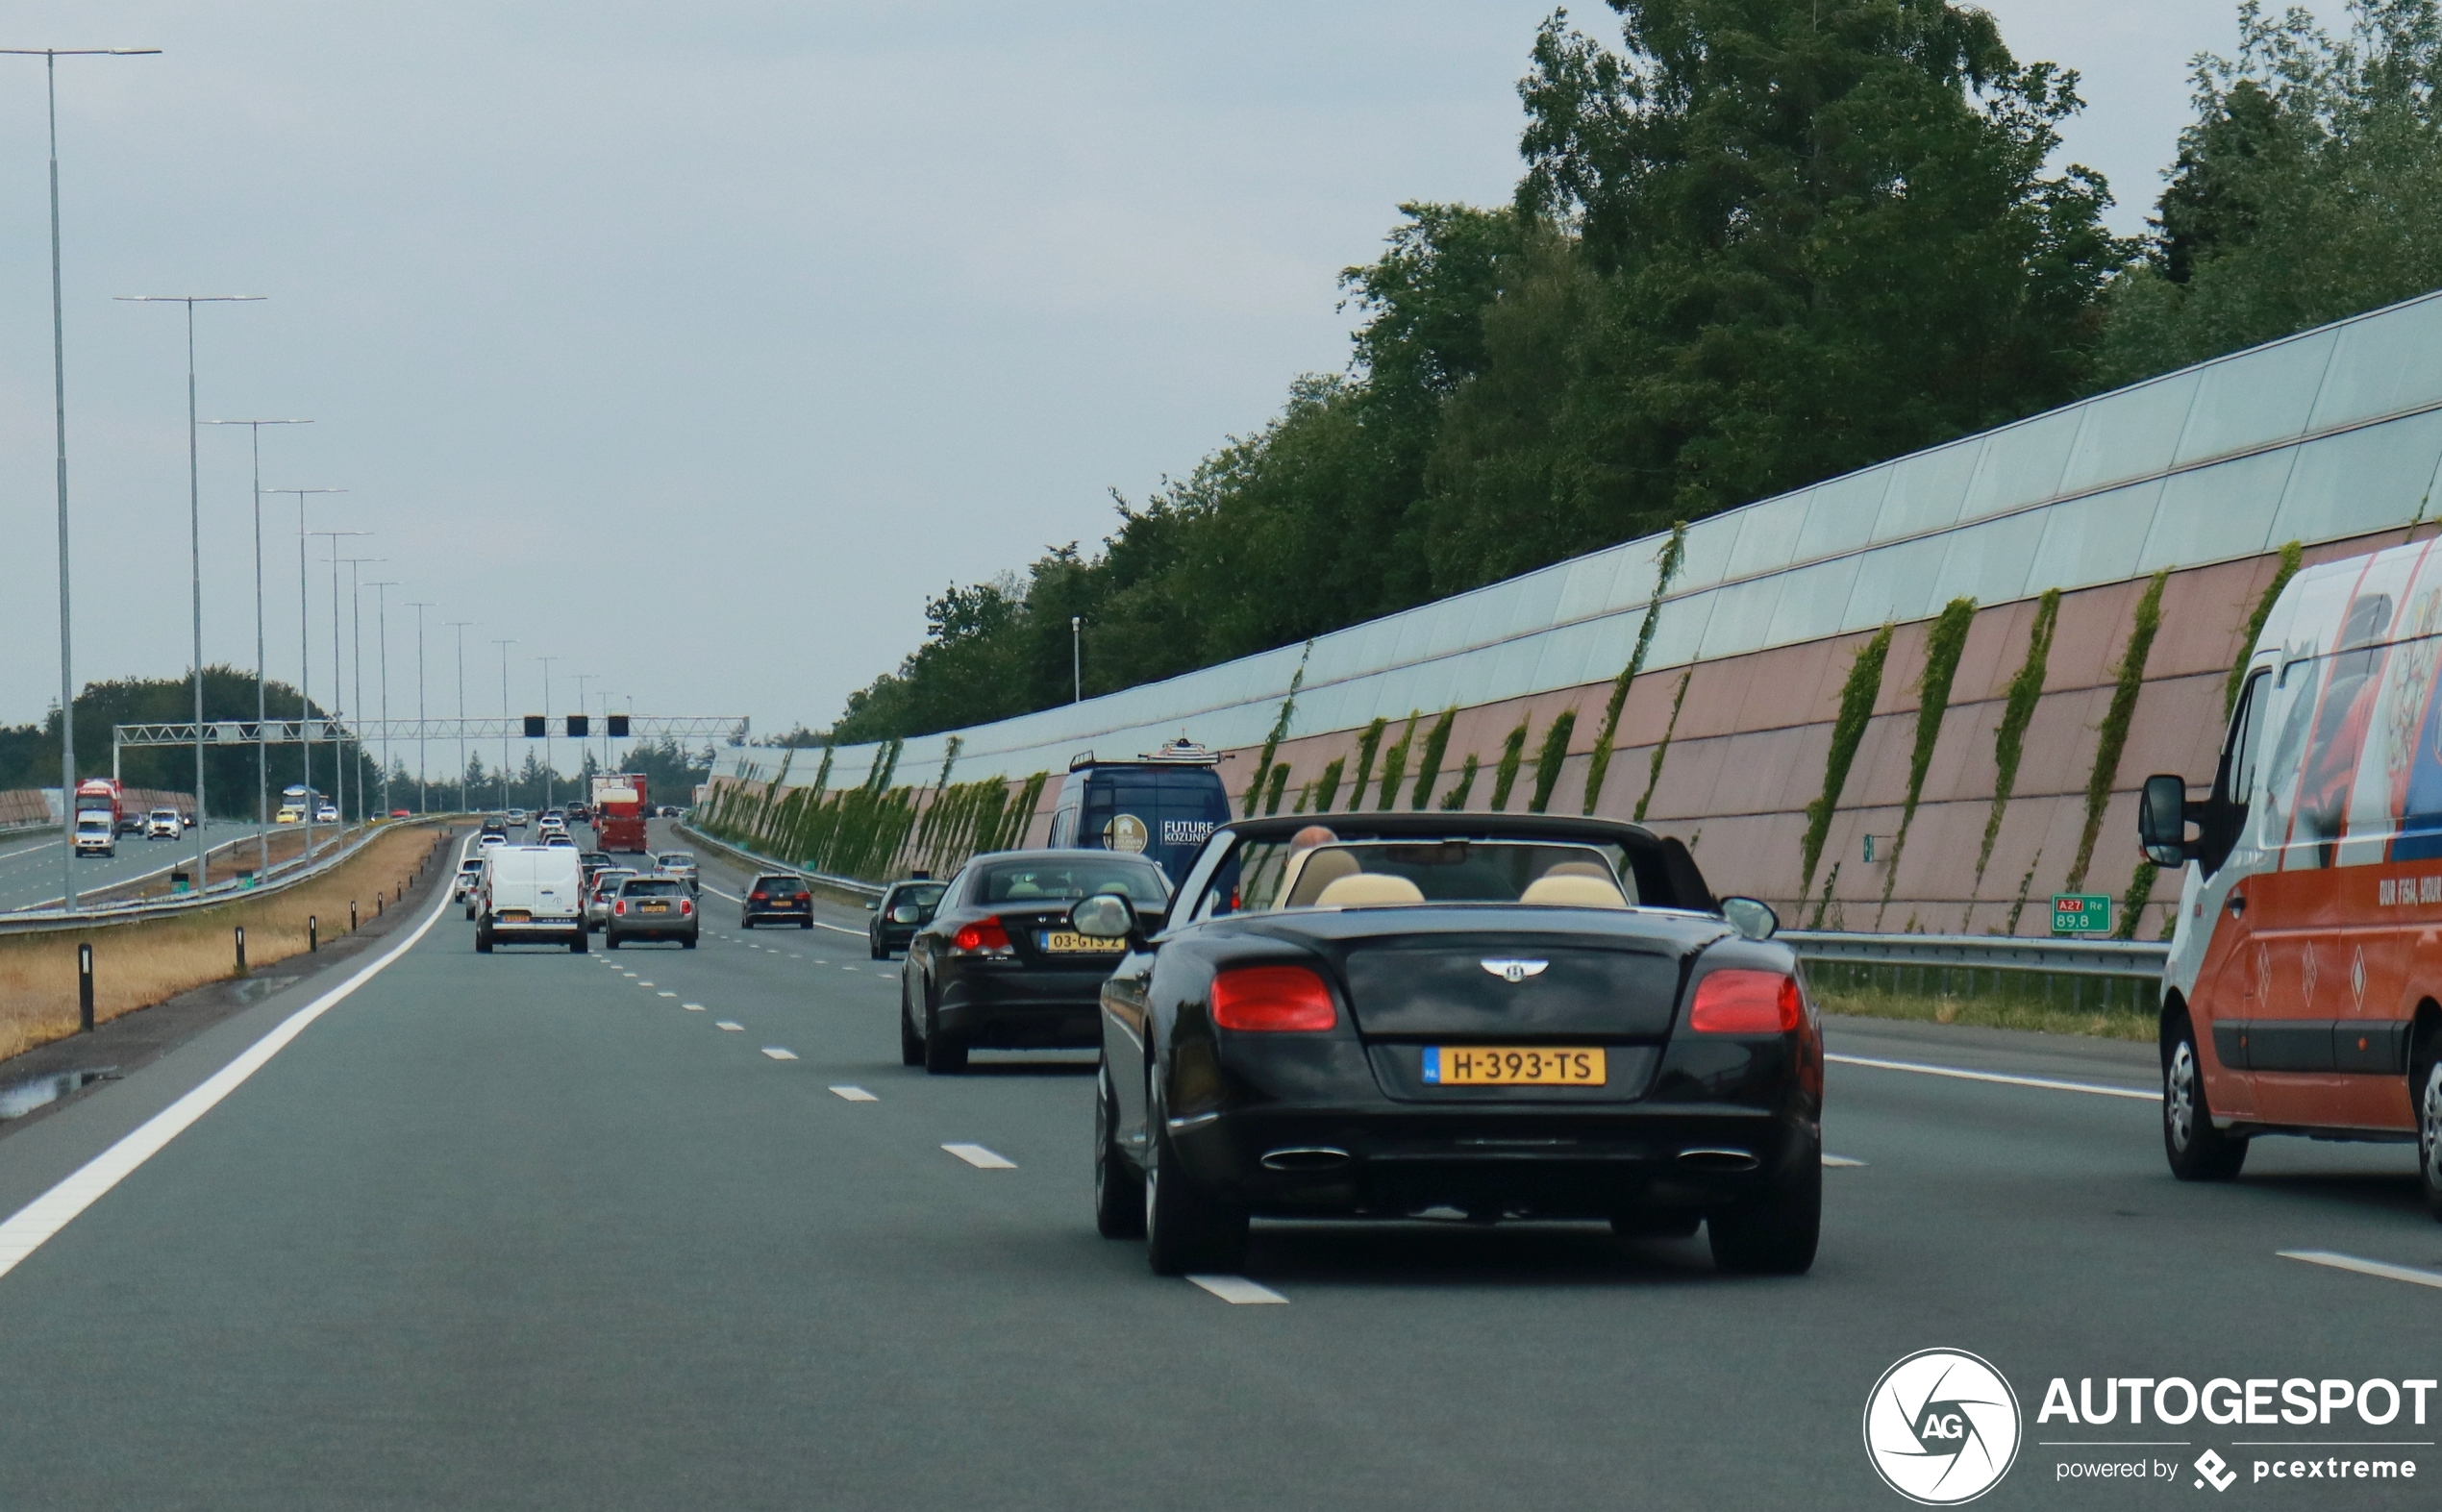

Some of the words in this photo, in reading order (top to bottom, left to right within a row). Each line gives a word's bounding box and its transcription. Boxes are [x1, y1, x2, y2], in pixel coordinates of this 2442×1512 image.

[1164, 821, 1214, 833] FUTURE
[1164, 832, 1208, 843] KOZIJNE
[2380, 879, 2396, 906] OUR
[2058, 901, 2081, 910] A27
[2089, 902, 2103, 910] Re
[1454, 1053, 1591, 1078] H-393-TS
